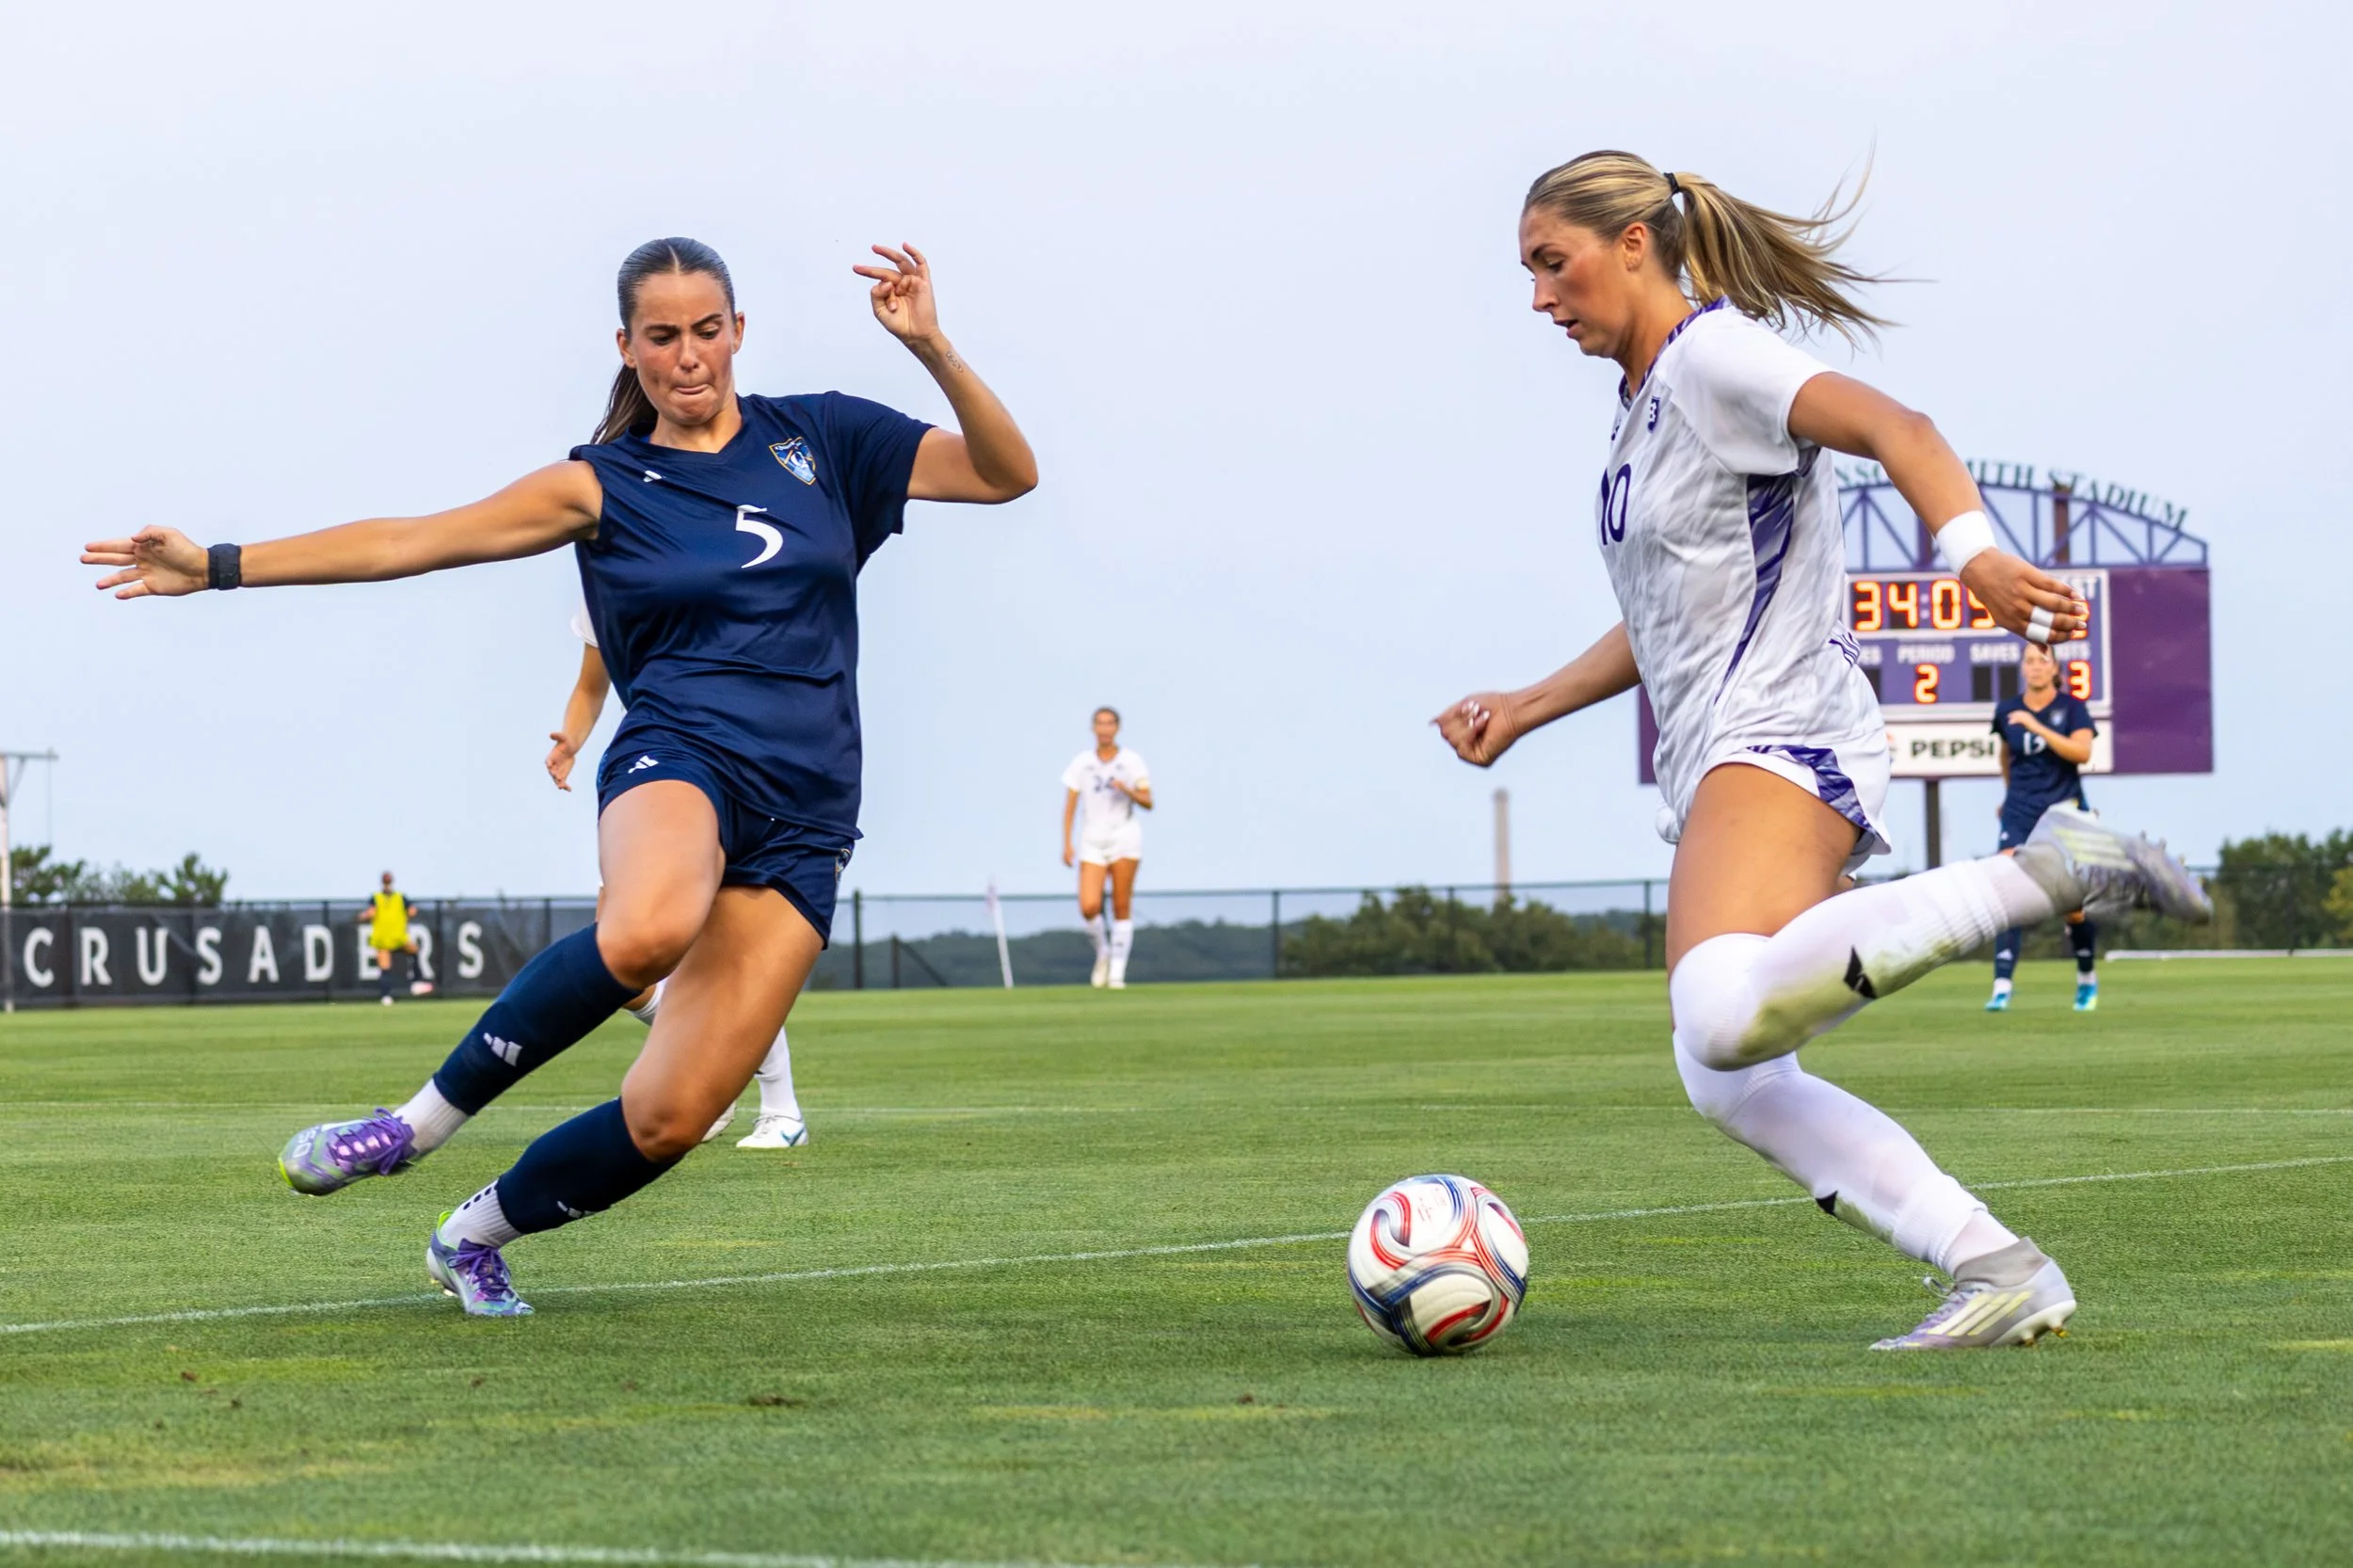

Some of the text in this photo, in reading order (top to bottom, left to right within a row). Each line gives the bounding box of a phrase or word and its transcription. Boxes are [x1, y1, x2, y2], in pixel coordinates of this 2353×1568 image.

[1601, 463, 1632, 546] 10
[2048, 469, 2188, 531] STADIUM
[735, 504, 784, 568] 5
[1913, 662, 1940, 704] 2
[2067, 660, 2091, 701] 3
[1911, 739, 1994, 759] PEPSI
[23, 920, 484, 987] CRUSADERS
